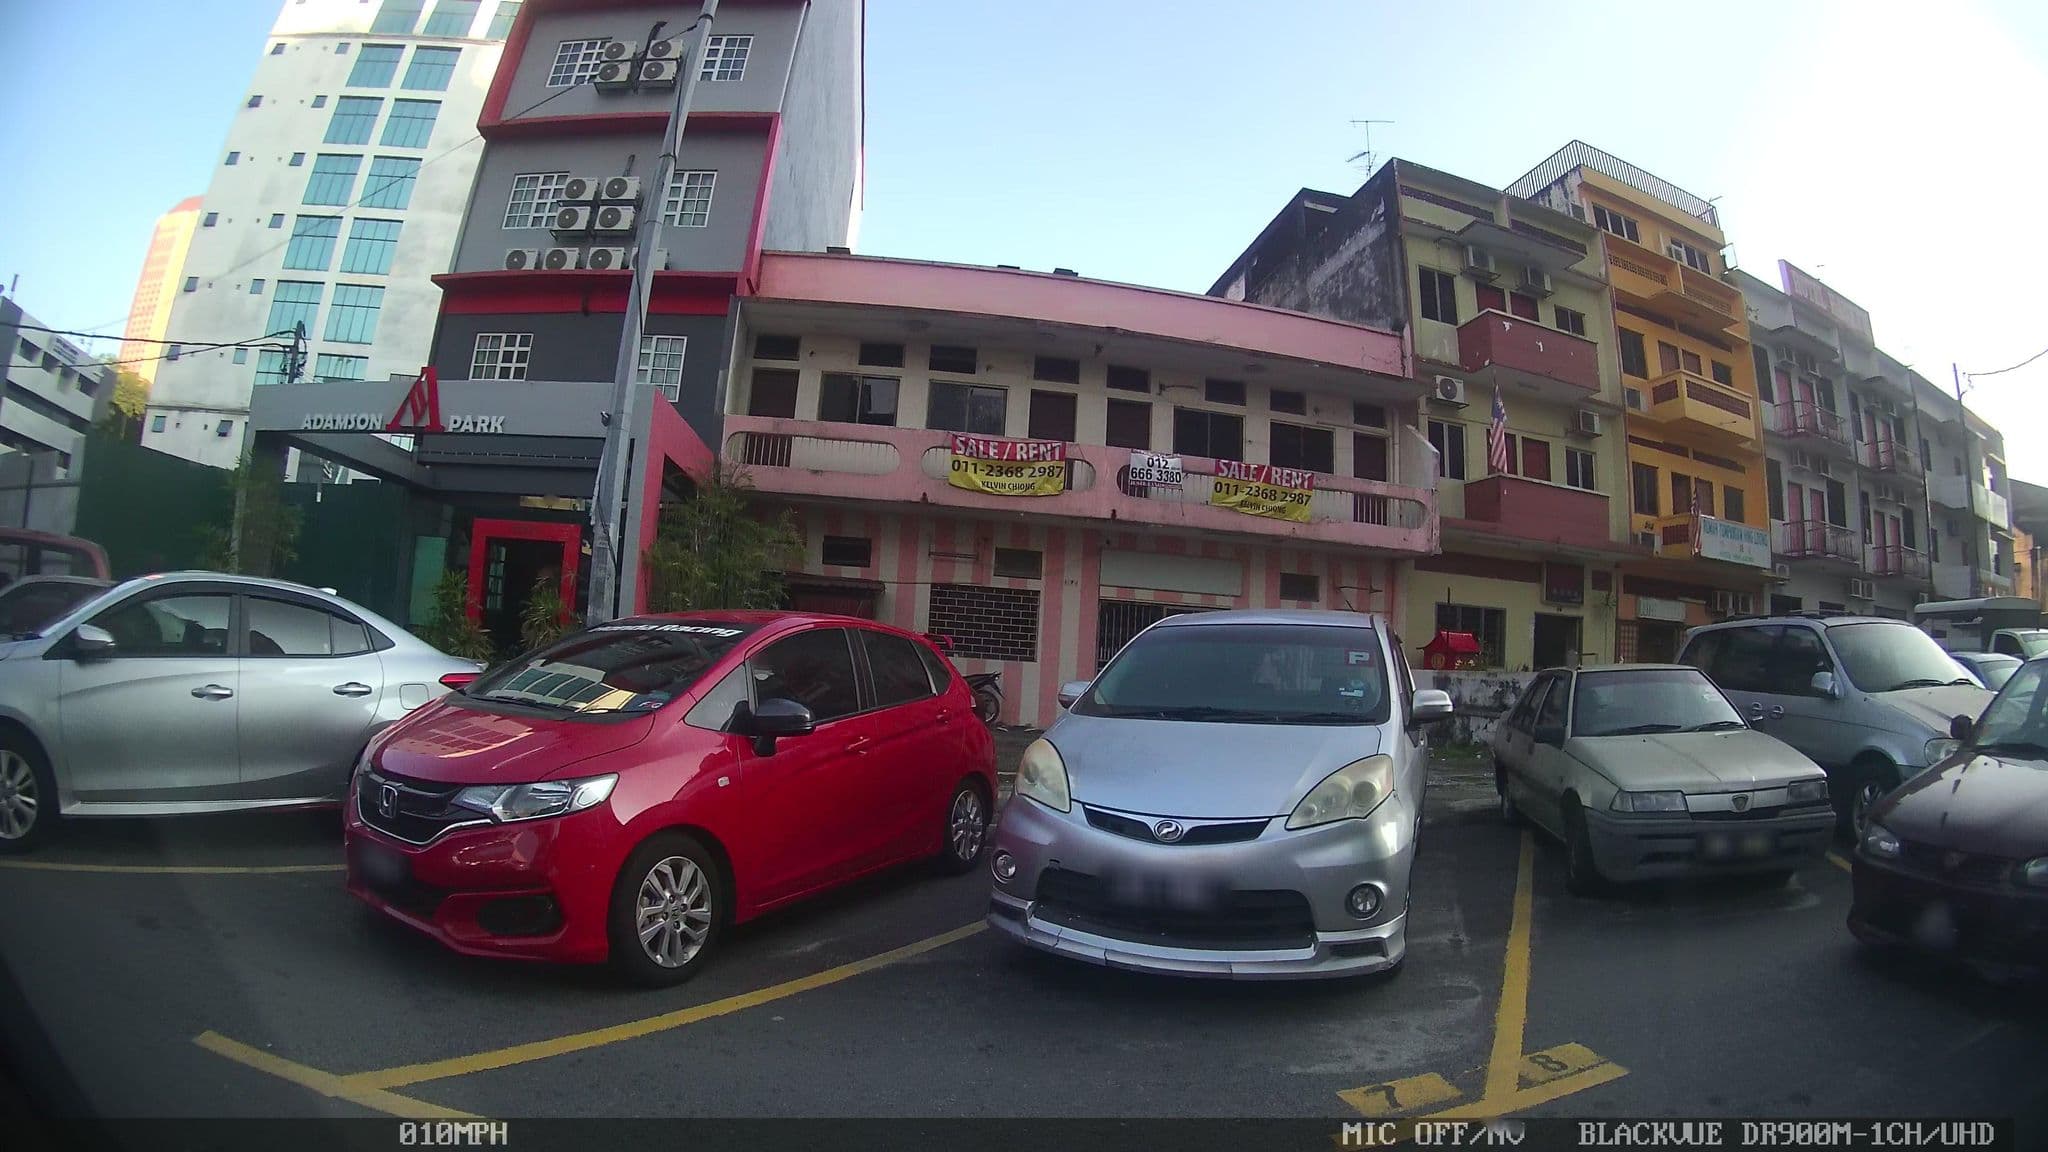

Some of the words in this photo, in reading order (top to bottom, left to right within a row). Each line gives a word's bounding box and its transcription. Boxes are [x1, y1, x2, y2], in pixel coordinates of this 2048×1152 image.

[302, 413, 384, 431] ADAMSON
[449, 415, 506, 434] PARK
[955, 436, 999, 459] SALE
[1016, 442, 1063, 461] RENT
[951, 459, 1024, 479] 011-2368
[1027, 464, 1065, 479] 2987
[1147, 457, 1170, 470] 012
[1130, 467, 1153, 480] 666
[1156, 469, 1182, 484] 3380
[1218, 459, 1259, 482] SALE
[1270, 466, 1314, 490] RENT
[981, 480, 1007, 490] KELVIN
[1007, 482, 1035, 491] CHIONG
[1214, 481, 1277, 501] 011-2368
[1279, 489, 1313, 507] 2987
[655, 624, 744, 638] Racing
[1349, 651, 1370, 664] P
[1529, 1054, 1568, 1073] 8
[1363, 1083, 1402, 1108] 7
